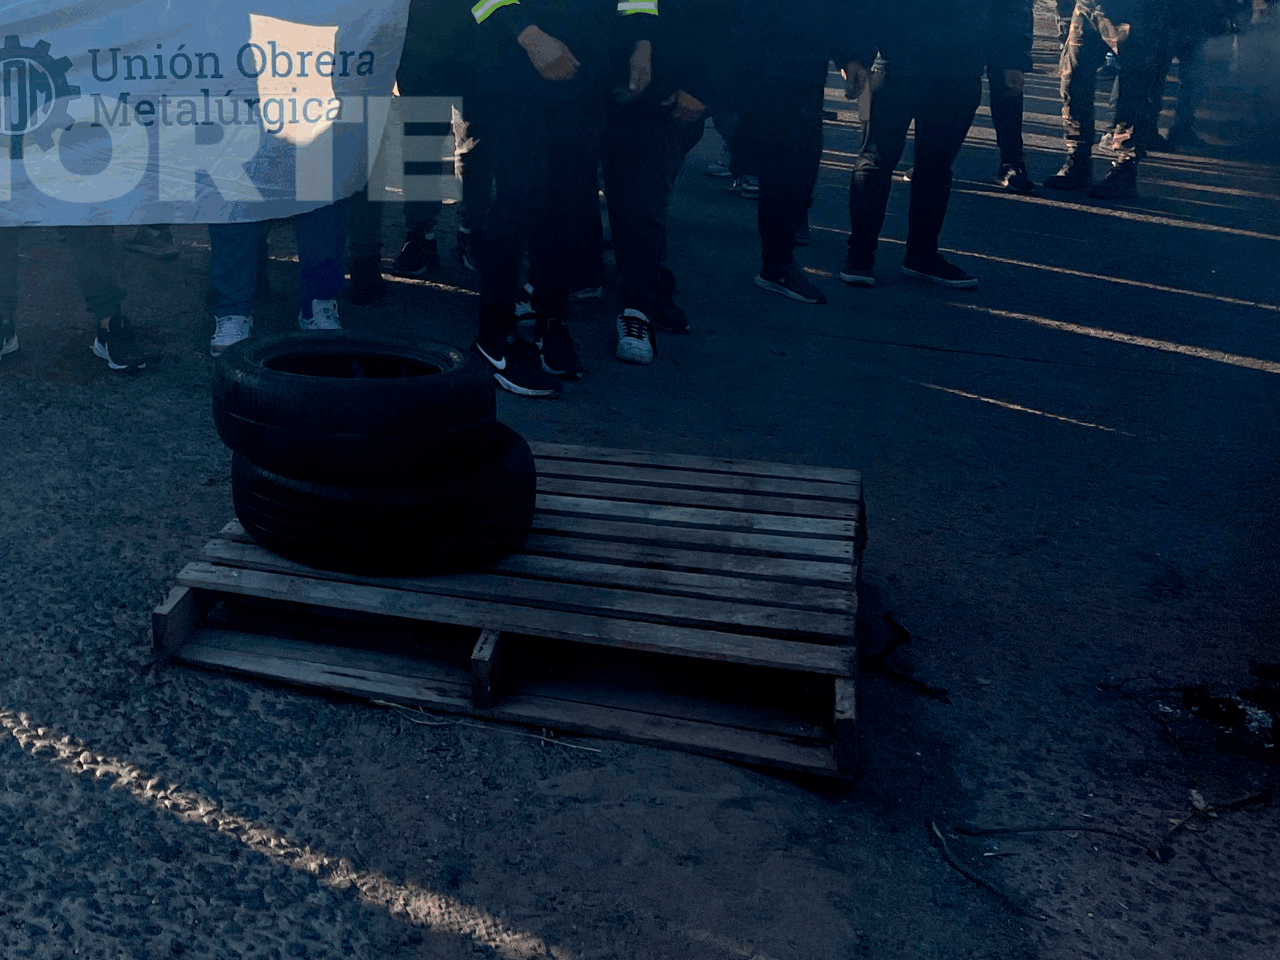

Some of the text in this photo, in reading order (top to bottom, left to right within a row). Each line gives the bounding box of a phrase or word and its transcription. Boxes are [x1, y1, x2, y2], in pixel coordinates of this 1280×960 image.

[88, 41, 375, 82] Unión Obrera
[89, 88, 343, 134] Metalúrgica
